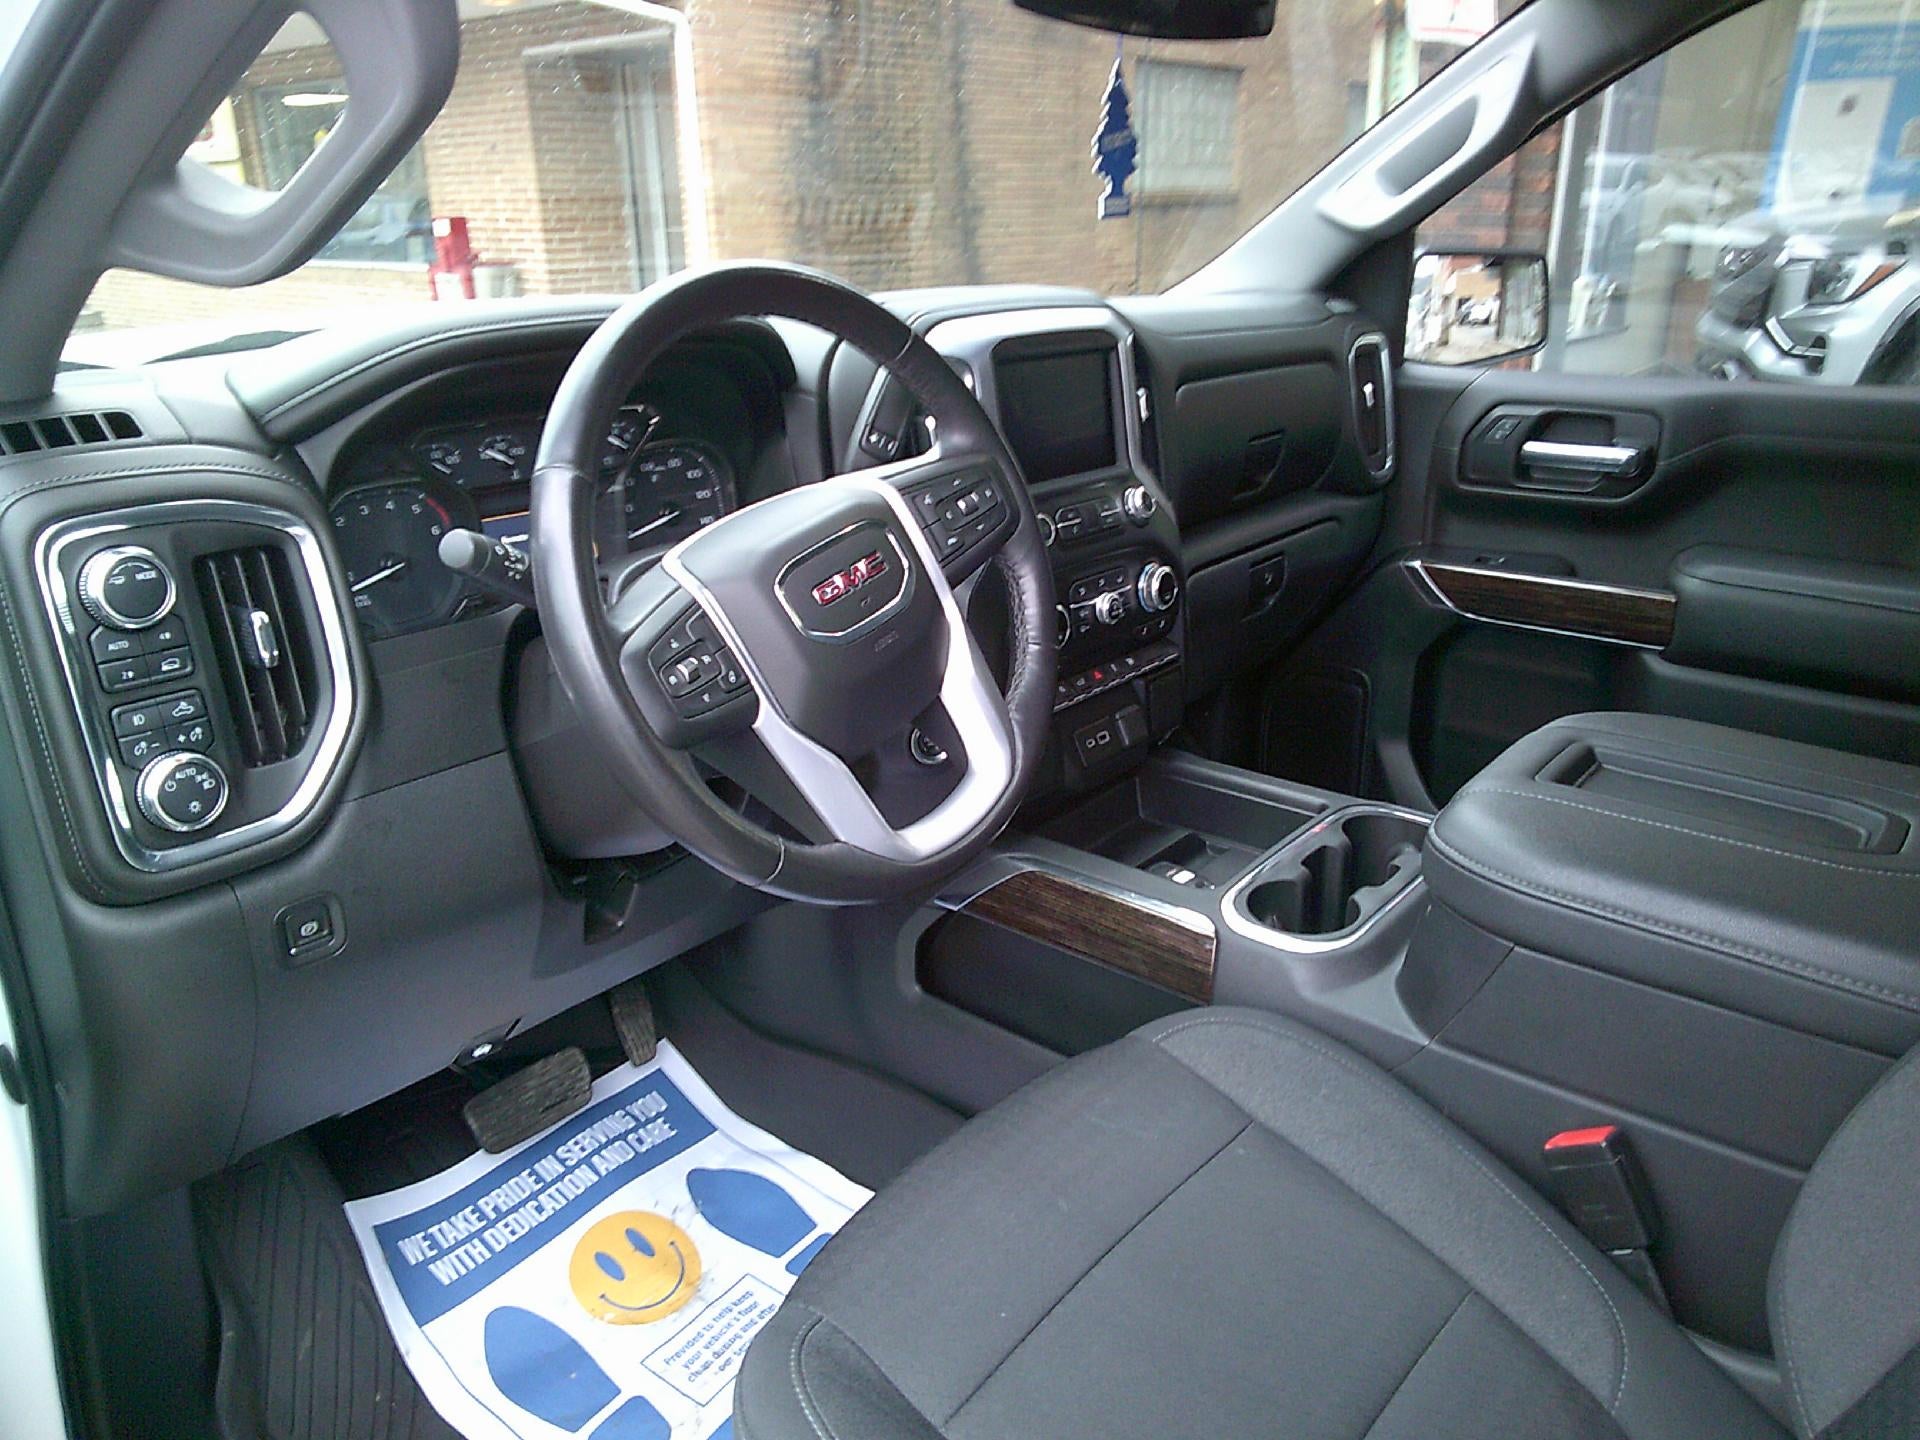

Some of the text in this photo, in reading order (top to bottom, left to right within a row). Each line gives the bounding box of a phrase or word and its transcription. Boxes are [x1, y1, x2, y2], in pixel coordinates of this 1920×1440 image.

[360, 505, 368, 515] 3
[385, 501, 394, 510] 4
[411, 504, 421, 514] 5
[336, 517, 344, 527] 2
[431, 525, 440, 535] 6
[811, 551, 888, 607] GMC
[108, 640, 130, 651] AUTO
[175, 767, 197, 779] AUTO
[397, 1090, 669, 1266] WE TAKE PRIDE IN SERVING YOU
[427, 1116, 679, 1286] WITH DEDICATION AND CARE
[664, 1290, 755, 1366] Provided to help keep
[687, 1360, 714, 1383] clean
[712, 1332, 743, 1360] during
[740, 1317, 759, 1333] and
[682, 1350, 703, 1370] your
